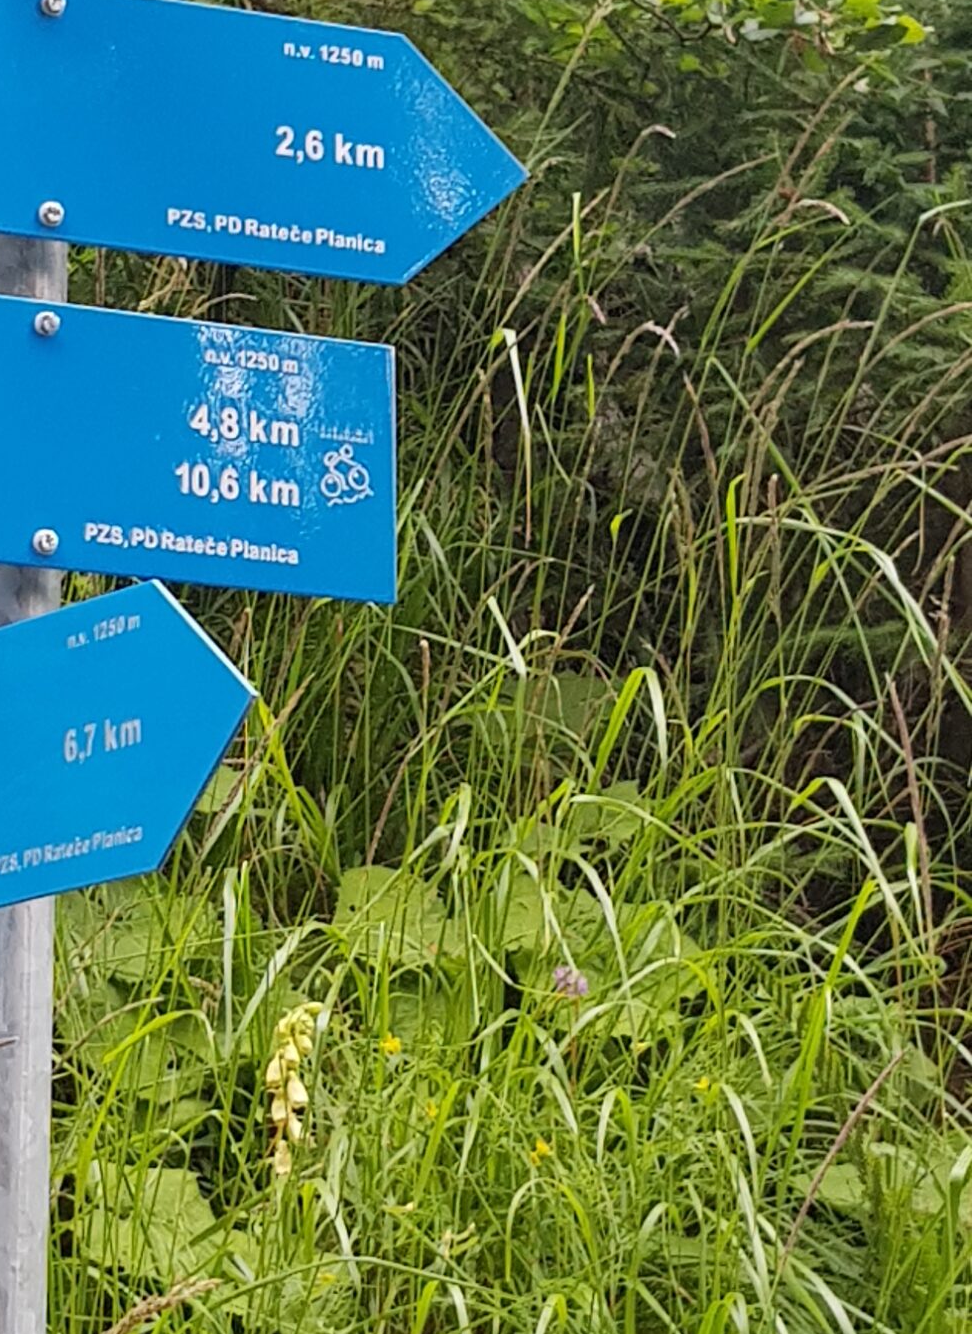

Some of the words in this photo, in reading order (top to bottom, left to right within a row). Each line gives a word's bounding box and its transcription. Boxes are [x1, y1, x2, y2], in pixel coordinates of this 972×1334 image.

[284, 43, 313, 58] n.v.
[320, 45, 363, 66] 1250
[367, 56, 384, 69] m
[276, 126, 324, 163] 2,6
[335, 133, 384, 169] km
[168, 208, 211, 232] PZS,
[215, 215, 242, 233] PD
[245, 219, 312, 243] Rateče
[315, 228, 385, 253] Planica
[236, 350, 279, 373] 1250
[281, 360, 298, 374] m
[190, 403, 240, 445] 4,8
[250, 410, 300, 446] km
[175, 461, 241, 503] 10,6
[250, 470, 299, 506] km
[84, 523, 128, 548] PZS,
[130, 527, 159, 548] PD
[160, 530, 228, 556] Rateče
[230, 539, 298, 564] Planica
[93, 616, 125, 640] 1250
[128, 616, 140, 630] m
[64, 723, 96, 762] 6,7
[105, 719, 141, 751] km
[23, 847, 42, 867] PD
[91, 827, 142, 849] Planica
